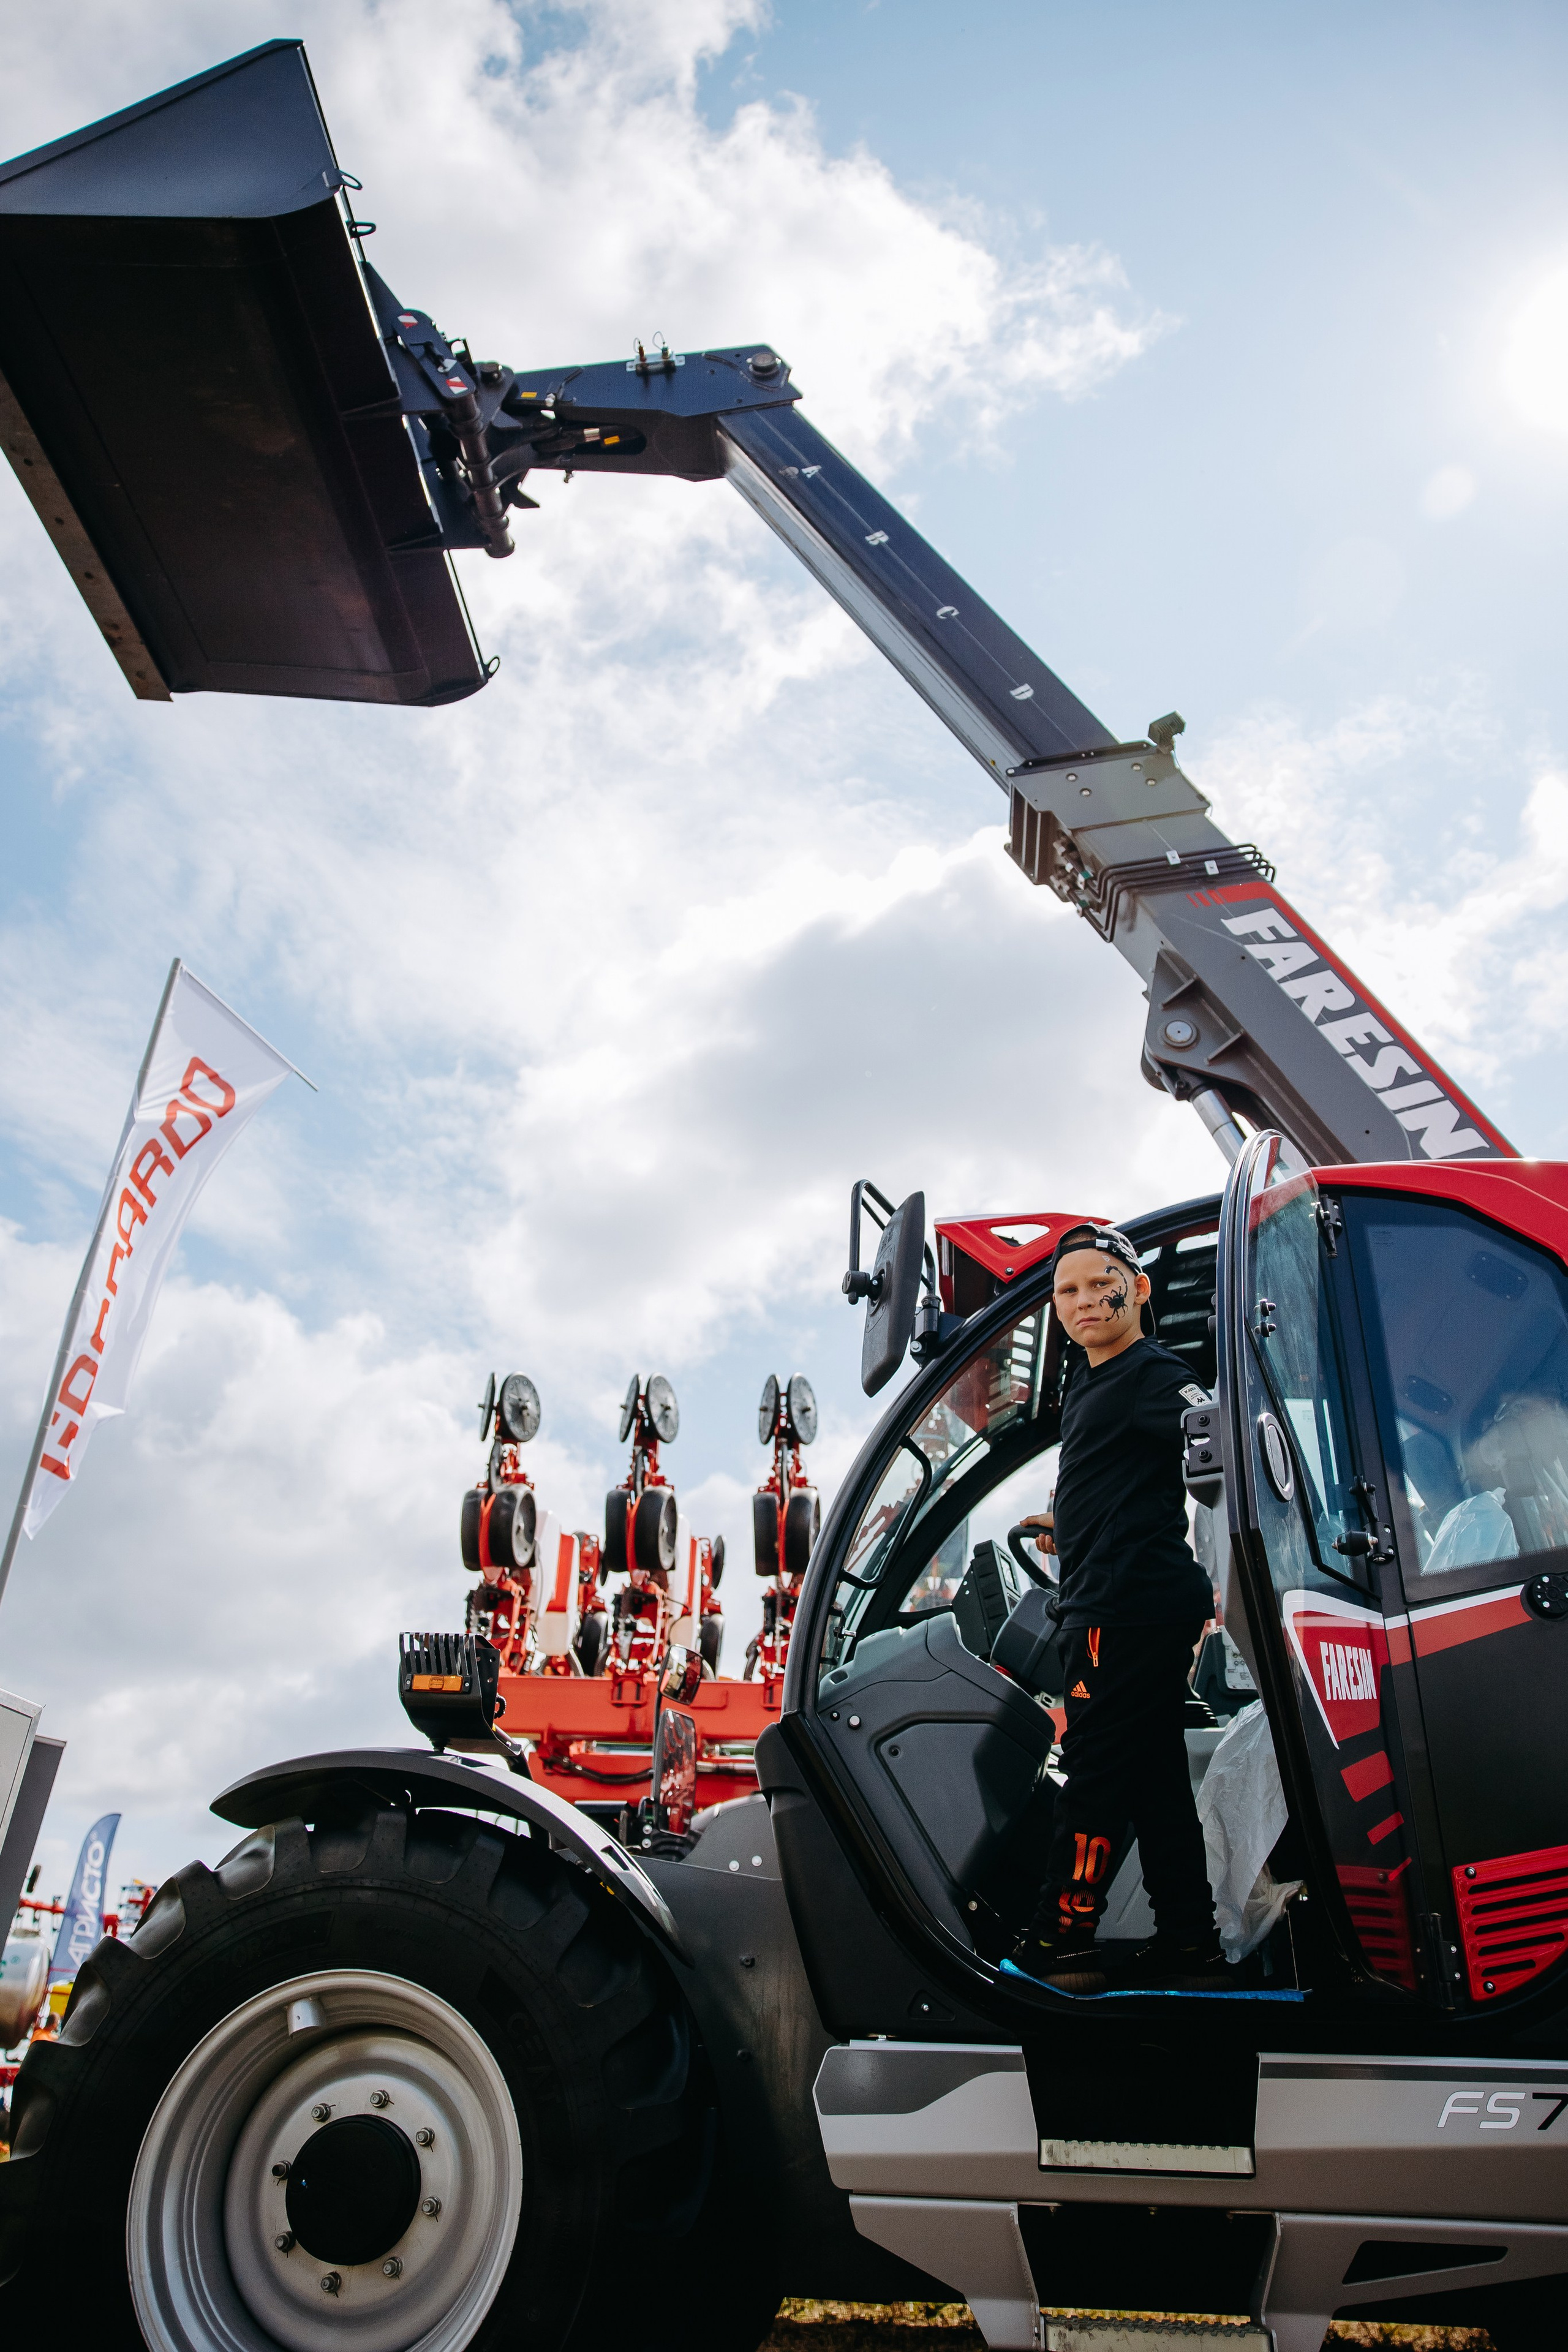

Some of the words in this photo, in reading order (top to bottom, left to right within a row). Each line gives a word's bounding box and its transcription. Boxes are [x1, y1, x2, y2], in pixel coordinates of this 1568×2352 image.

[865, 530, 890, 546] B
[937, 606, 960, 620] C
[1010, 683, 1035, 701] D
[1221, 907, 1490, 1160] FARESIN
[1319, 1642, 1378, 1701] FARESIN
[1072, 1833, 1111, 1884] 10
[67, 1839, 105, 1969] АГРИСТО
[1437, 2090, 1568, 2130] FS7
